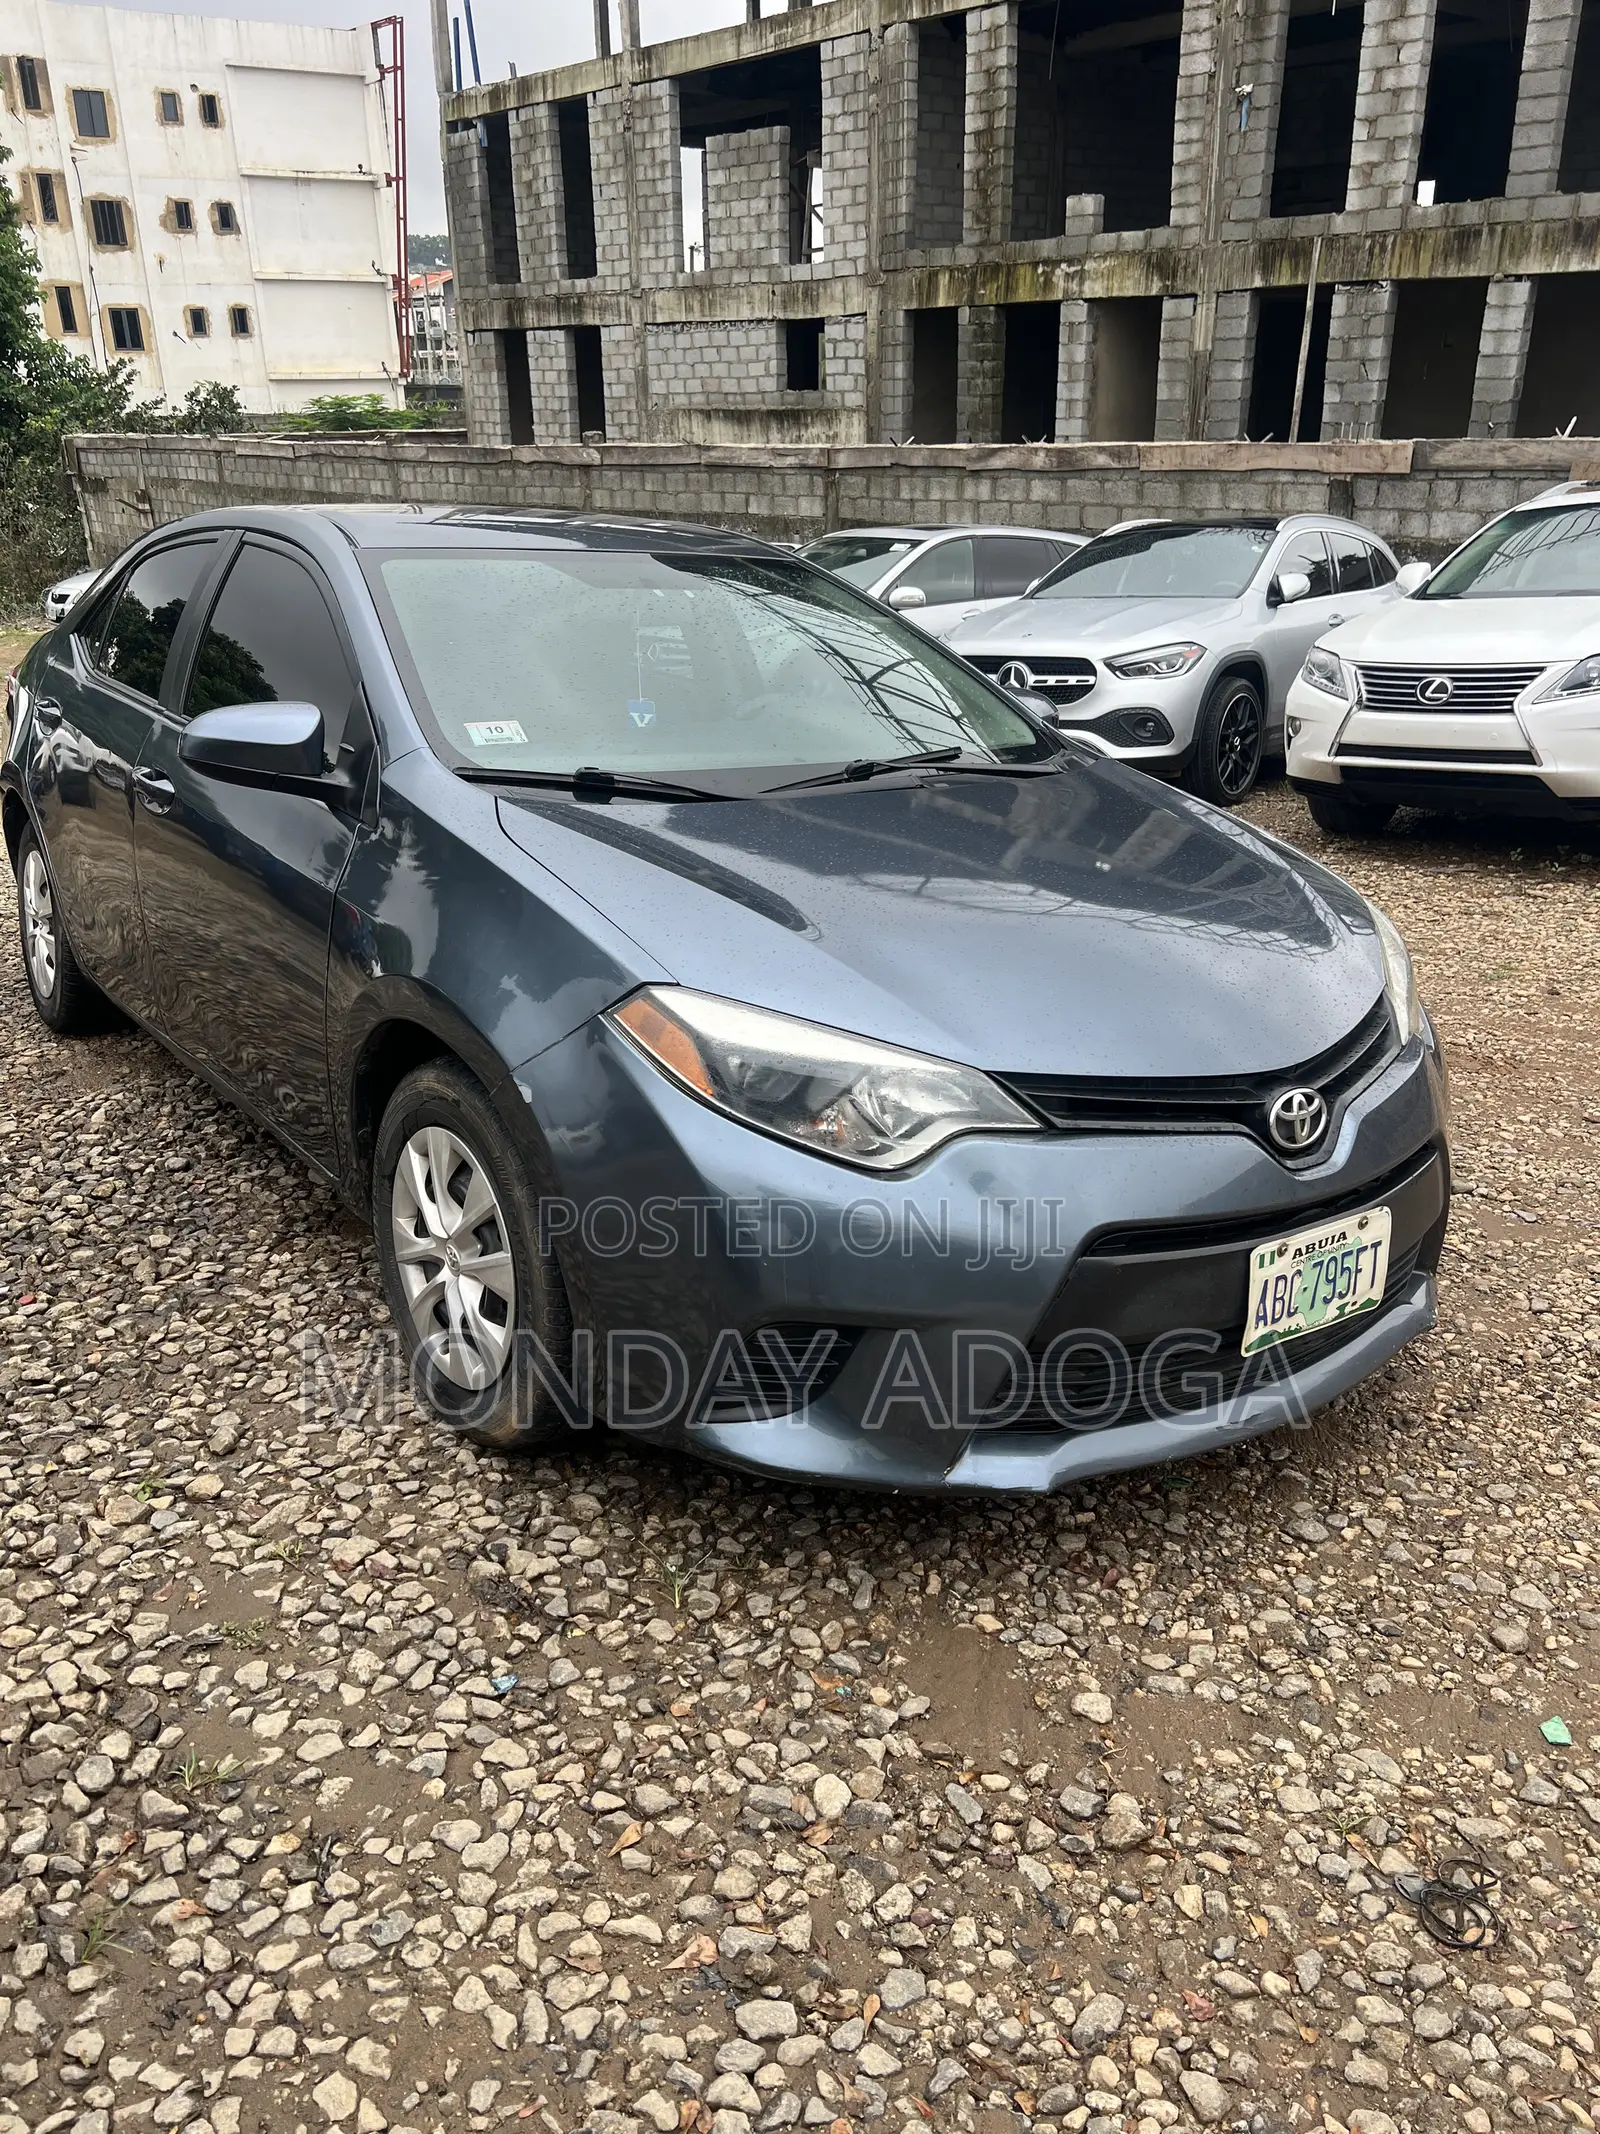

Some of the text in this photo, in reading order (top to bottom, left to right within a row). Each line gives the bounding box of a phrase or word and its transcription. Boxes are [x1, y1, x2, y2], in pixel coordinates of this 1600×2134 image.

[486, 726, 504, 735] 10
[1291, 1231, 1348, 1260] ABUJA
[1290, 1253, 1317, 1269] CENTRE
[1316, 1249, 1328, 1259] OF
[1254, 1239, 1383, 1330] ABC-795FT
